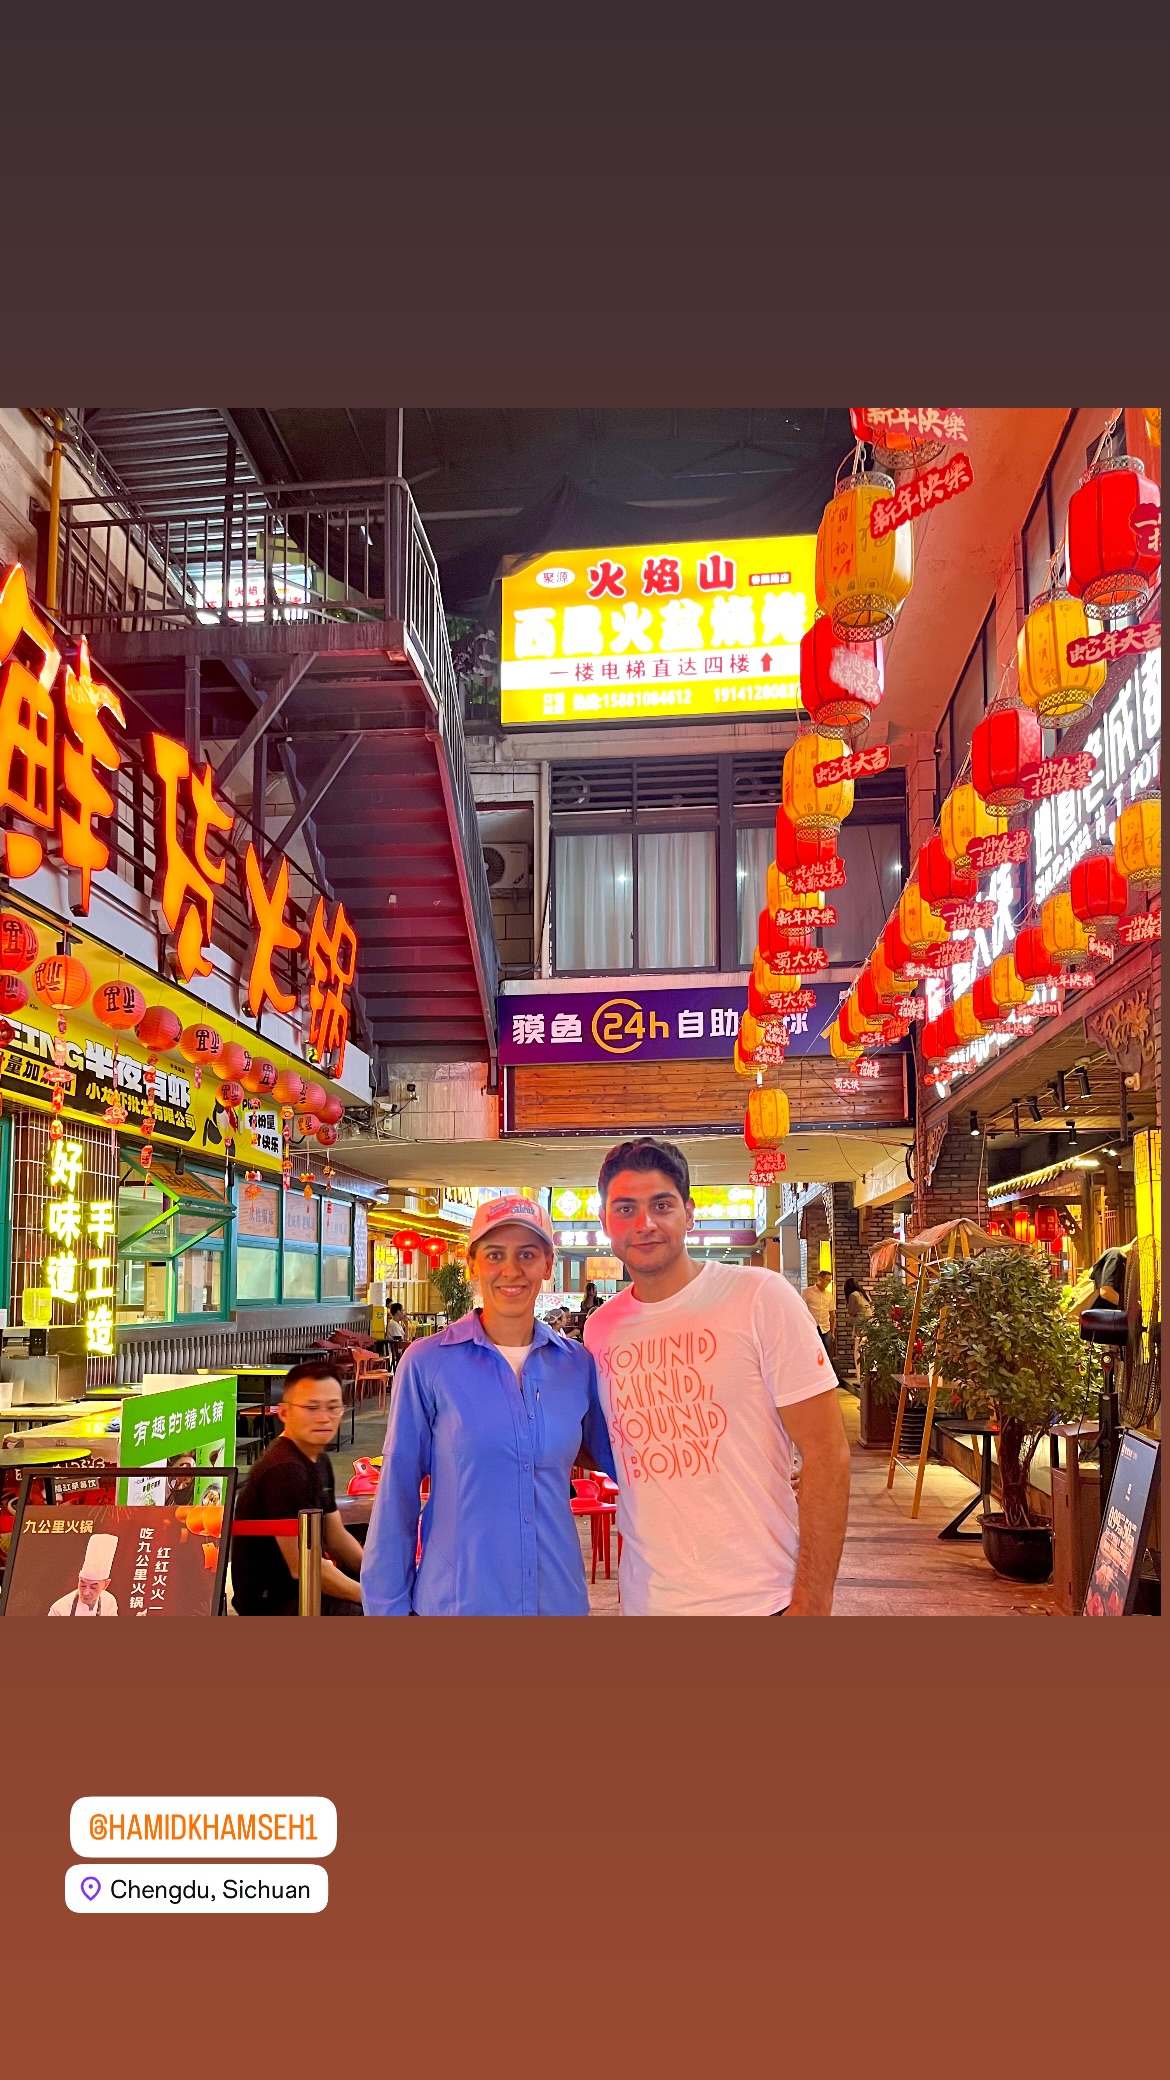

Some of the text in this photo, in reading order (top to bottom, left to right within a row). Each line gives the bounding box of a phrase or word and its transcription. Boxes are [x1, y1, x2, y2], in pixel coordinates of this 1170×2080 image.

[542, 571, 569, 584] 聚源
[587, 554, 736, 598] 火焰山
[550, 653, 751, 682] 一楼电梯直达四楼
[816, 747, 887, 784] 蛇年大吉
[793, 875, 845, 893] 成都火锅
[795, 858, 837, 880] 吃地道
[774, 950, 828, 969] 蜀大侠
[767, 991, 815, 1009] 蜀大侠
[604, 1011, 670, 1041] 24h
[678, 1007, 809, 1040] 自助球
[833, 1079, 860, 1091] 蜀大侠
[47, 1141, 83, 1304] 好味道
[86, 1200, 118, 1355] 手工造
[599, 1329, 716, 1377] SOUND
[610, 1402, 727, 1448] SOUND
[621, 1437, 720, 1487] BODY
[22, 1519, 94, 1535] 九公里火锅
